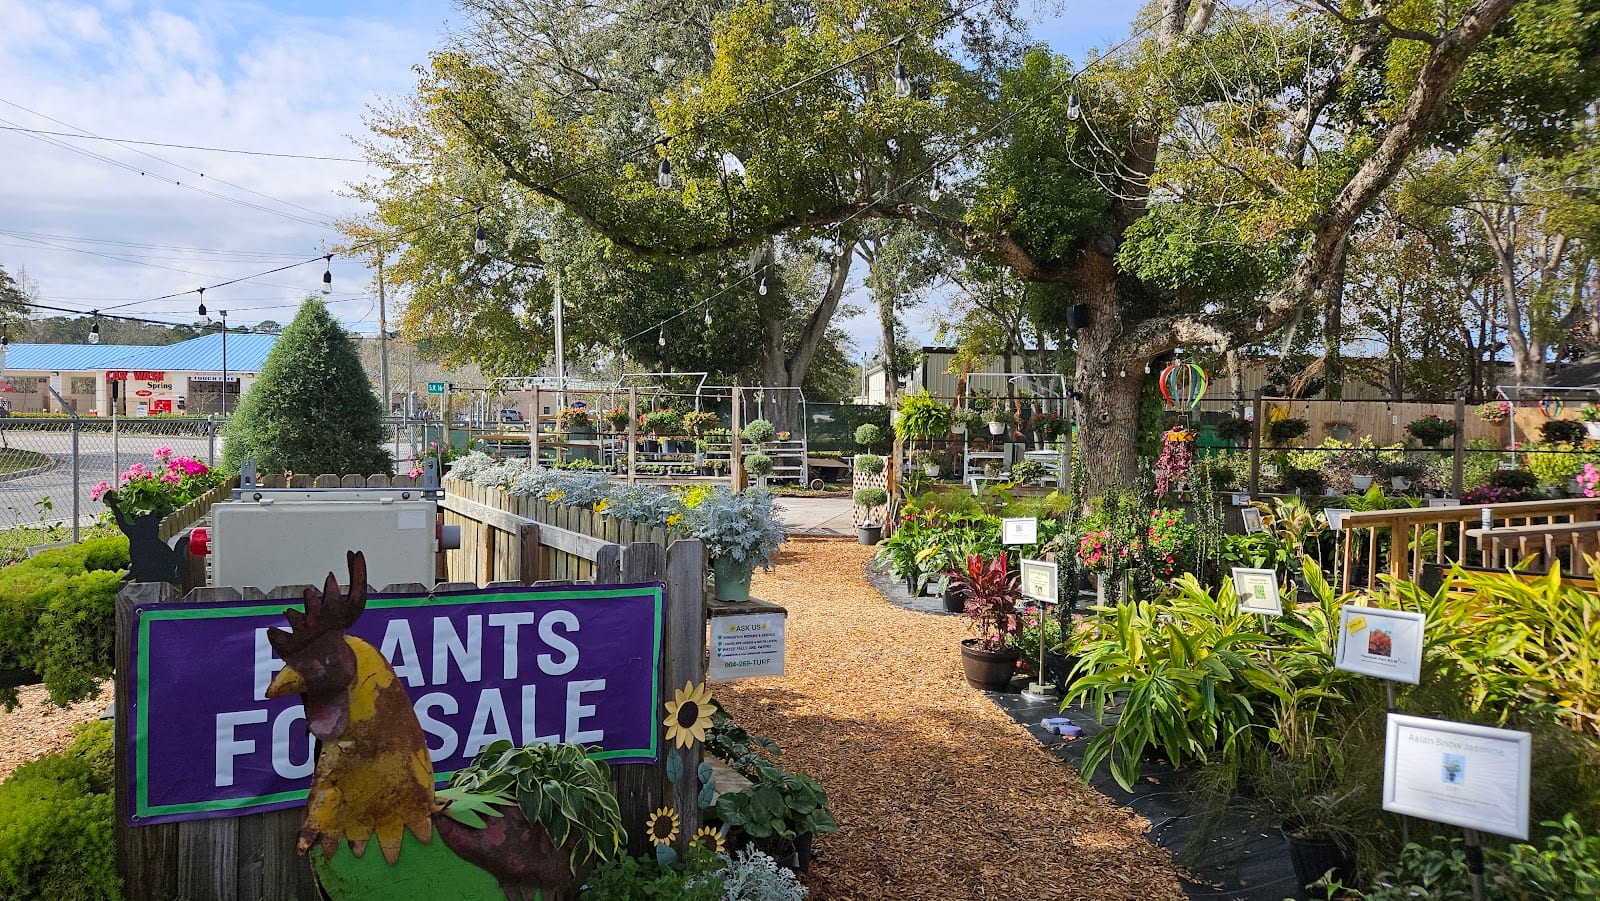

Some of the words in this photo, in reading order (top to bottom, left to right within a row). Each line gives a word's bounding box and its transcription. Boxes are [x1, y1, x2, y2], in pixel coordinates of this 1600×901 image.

[105, 371, 128, 381] CAR
[133, 371, 164, 381] WASH
[147, 382, 173, 390] Spring
[735, 624, 750, 632] ASK
[253, 609, 580, 702] PANTS
[414, 679, 606, 764] SALE
[1408, 733, 1434, 745] Asian
[1435, 737, 1462, 750] Snow
[1463, 744, 1505, 757] Jasmine
